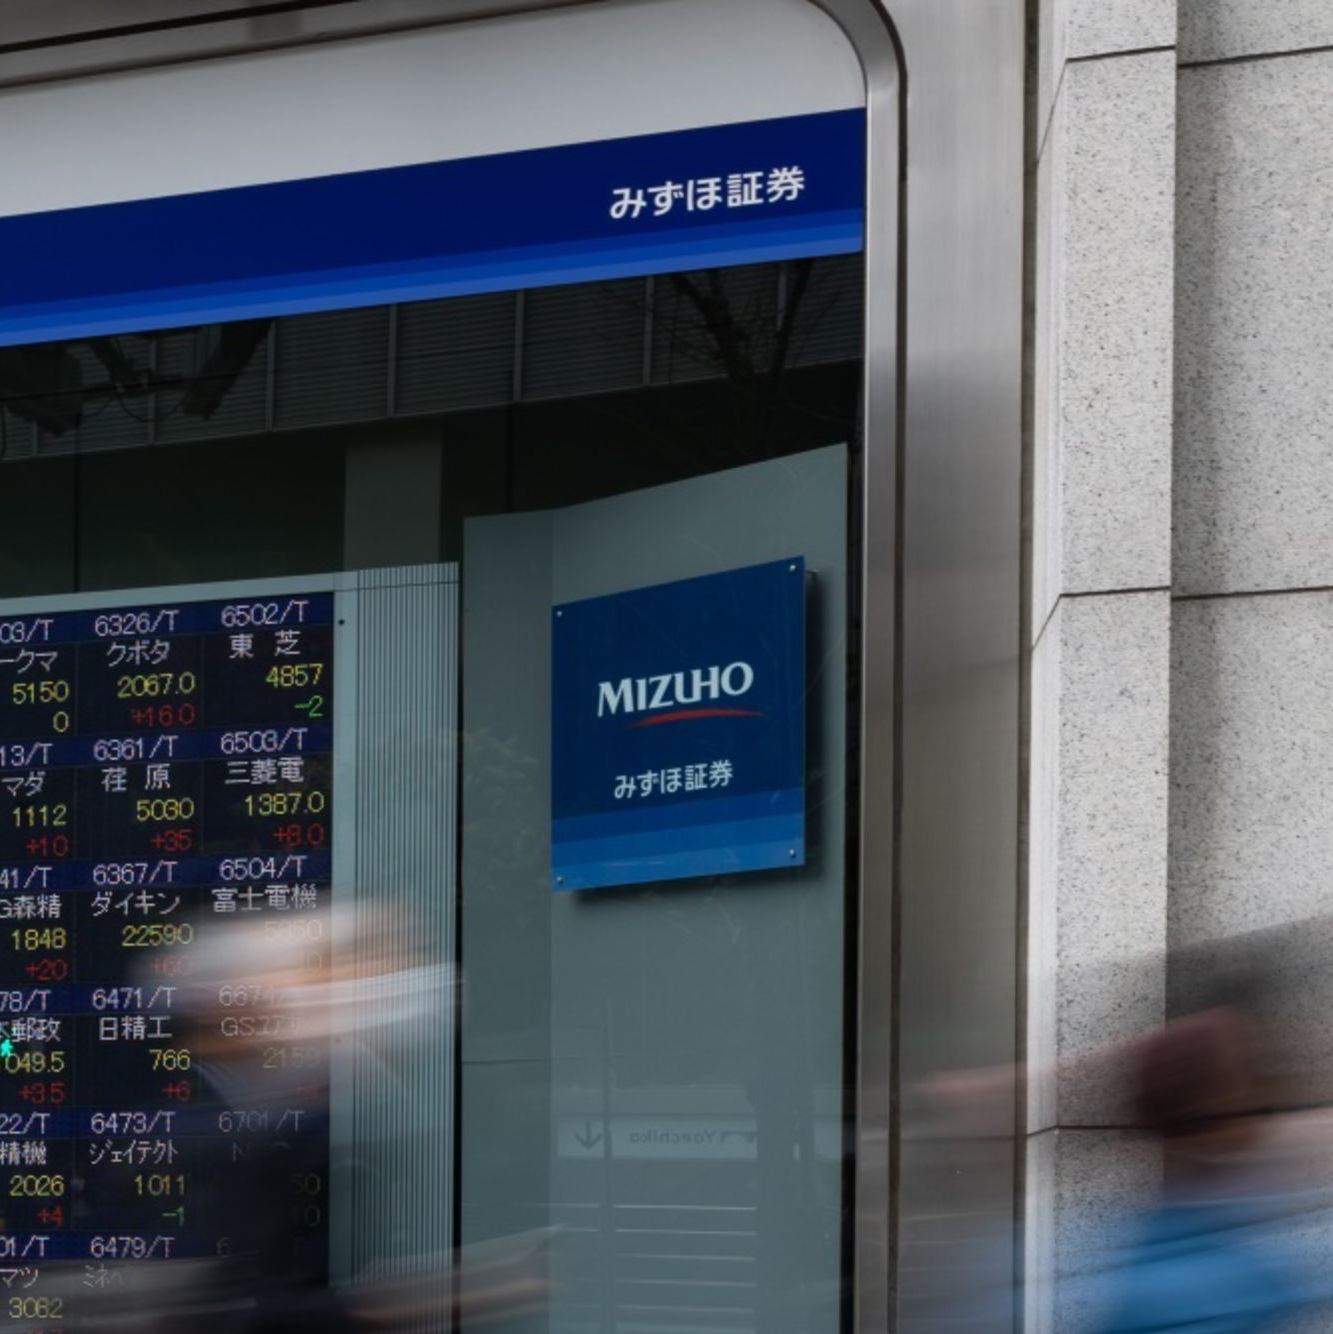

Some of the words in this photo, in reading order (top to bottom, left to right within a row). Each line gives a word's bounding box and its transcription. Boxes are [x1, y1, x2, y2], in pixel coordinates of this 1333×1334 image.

[610, 166, 805, 219] みずほ証券
[94, 609, 179, 638] 6326/T
[221, 600, 309, 628] 6502/T
[106, 639, 171, 667] クボタ
[266, 663, 324, 689] 4857
[597, 661, 753, 717] MIZUHO
[93, 735, 179, 761] 6361/T
[220, 728, 308, 754] 6503/T
[225, 757, 304, 785] 三菱電
[615, 759, 732, 798] みずほ証券
[136, 798, 194, 822] 5030
[93, 860, 178, 886] 6367/T
[219, 855, 307, 881] 6504/T
[91, 891, 181, 917] ダイキン
[211, 883, 317, 913] 富士電機
[92, 986, 177, 1011] 6471/T
[99, 1016, 172, 1041] 日精工
[91, 1109, 176, 1134] 6473/T
[89, 1140, 179, 1165] ジェイテクト
[135, 1175, 185, 1196] 1011
[90, 1235, 175, 1258] 6479/T
